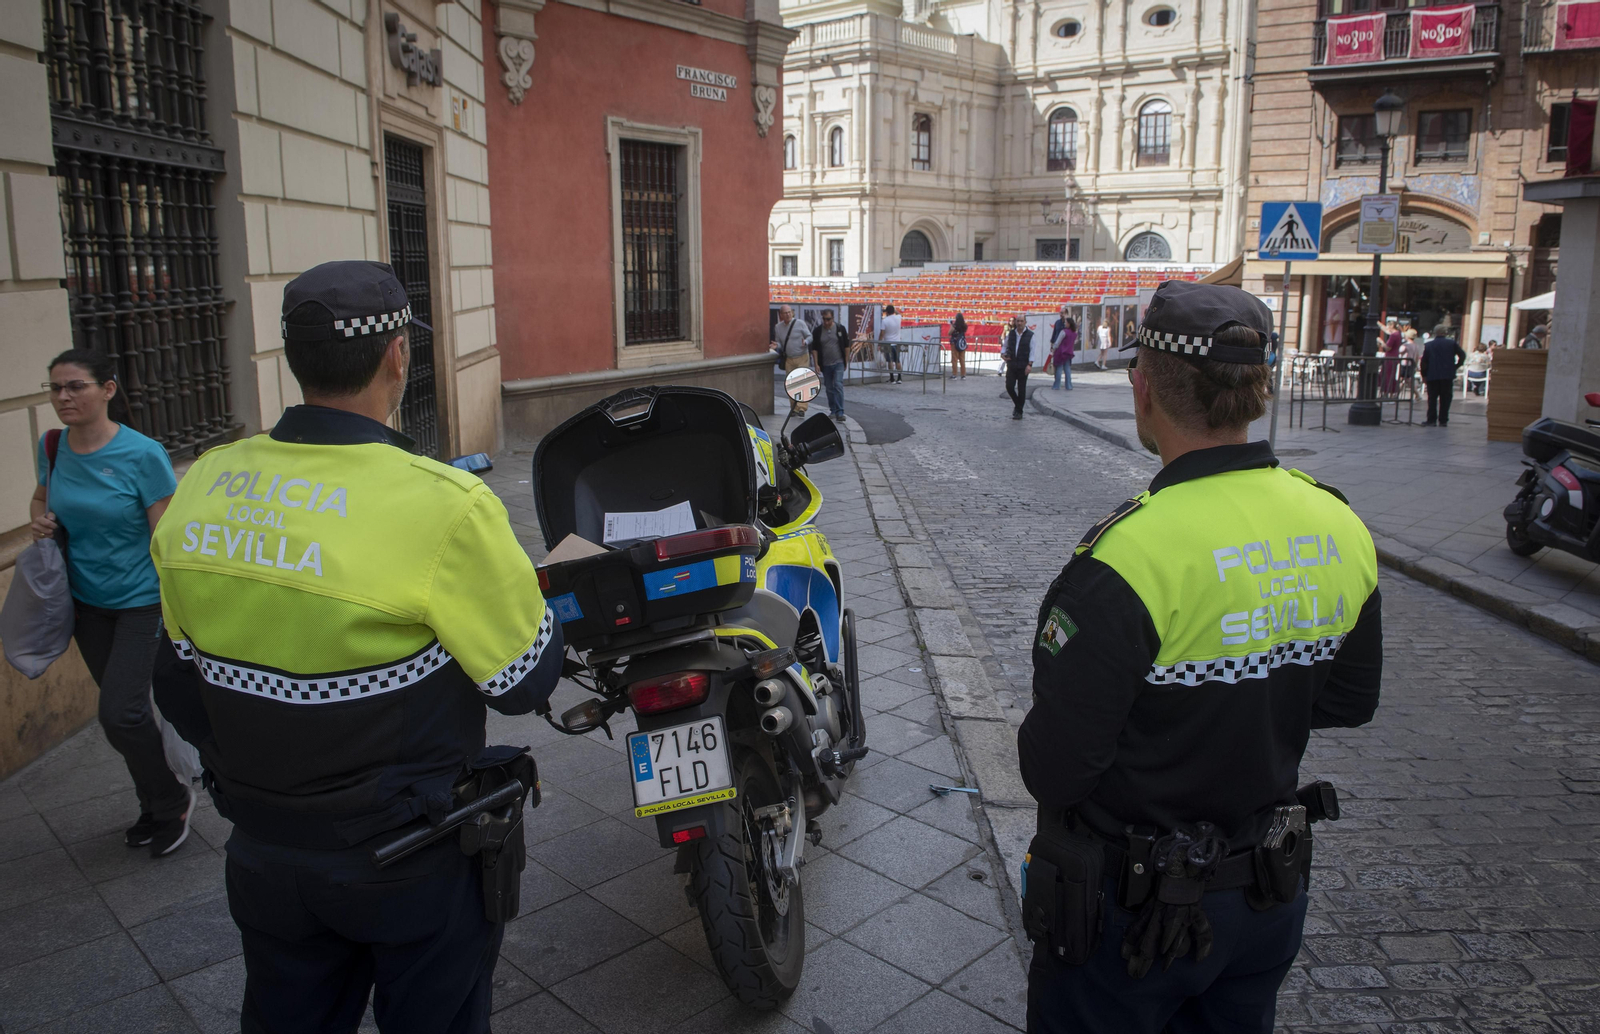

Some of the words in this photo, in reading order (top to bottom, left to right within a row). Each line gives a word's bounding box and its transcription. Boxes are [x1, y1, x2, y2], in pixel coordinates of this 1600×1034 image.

[1336, 30, 1374, 50] NO8DO
[1421, 23, 1462, 44] NO8DO
[677, 66, 737, 88] FRANCISCO
[692, 84, 726, 100] BRUNA
[206, 471, 348, 518] POLICIA
[226, 503, 287, 530] LOCAL
[182, 521, 324, 578] SEVILLA
[1212, 534, 1343, 583] POLICIA
[1258, 573, 1319, 599] LOCAL
[1220, 594, 1344, 645] SEVILLA
[651, 723, 717, 763] 7146
[639, 762, 648, 774] E
[659, 760, 709, 797] FLD
[673, 800, 696, 809] LOCAL
[697, 793, 726, 804] SEVILLA
